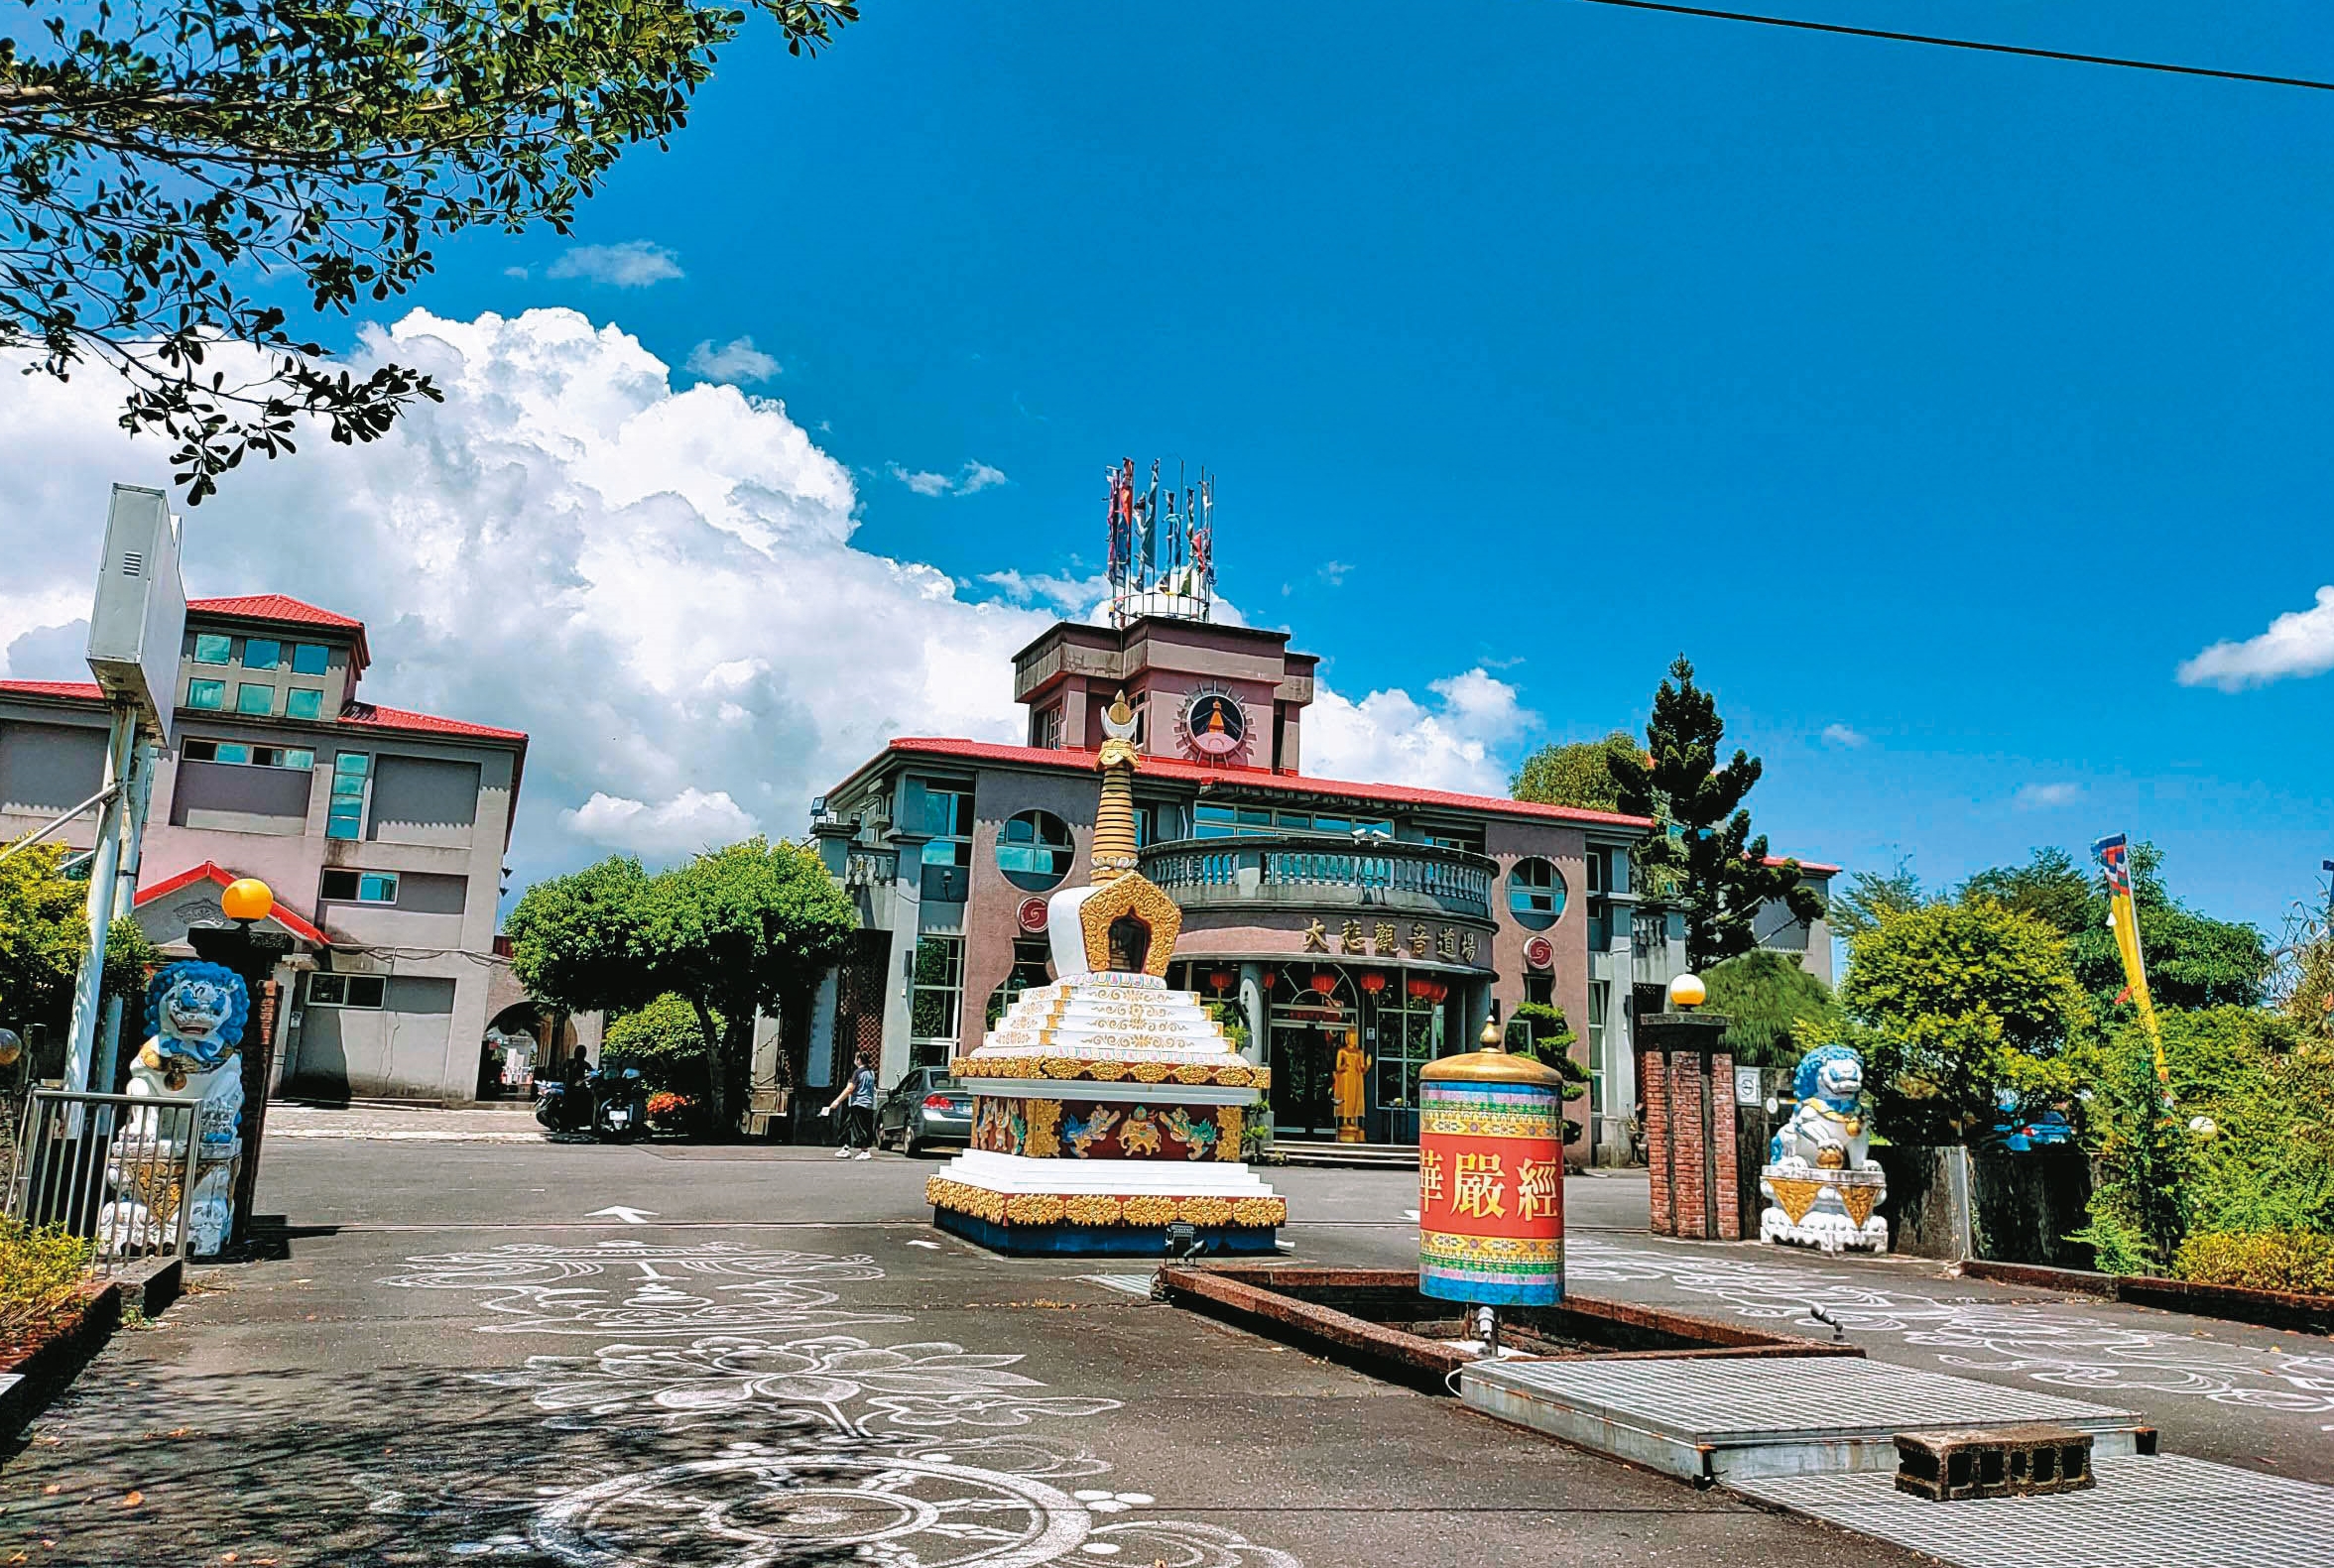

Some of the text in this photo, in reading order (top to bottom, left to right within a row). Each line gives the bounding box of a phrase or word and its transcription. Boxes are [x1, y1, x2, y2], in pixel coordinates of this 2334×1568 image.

[1302, 916, 1478, 963] 大悲觀音道場
[1418, 1148, 1558, 1222] 華嚴經
